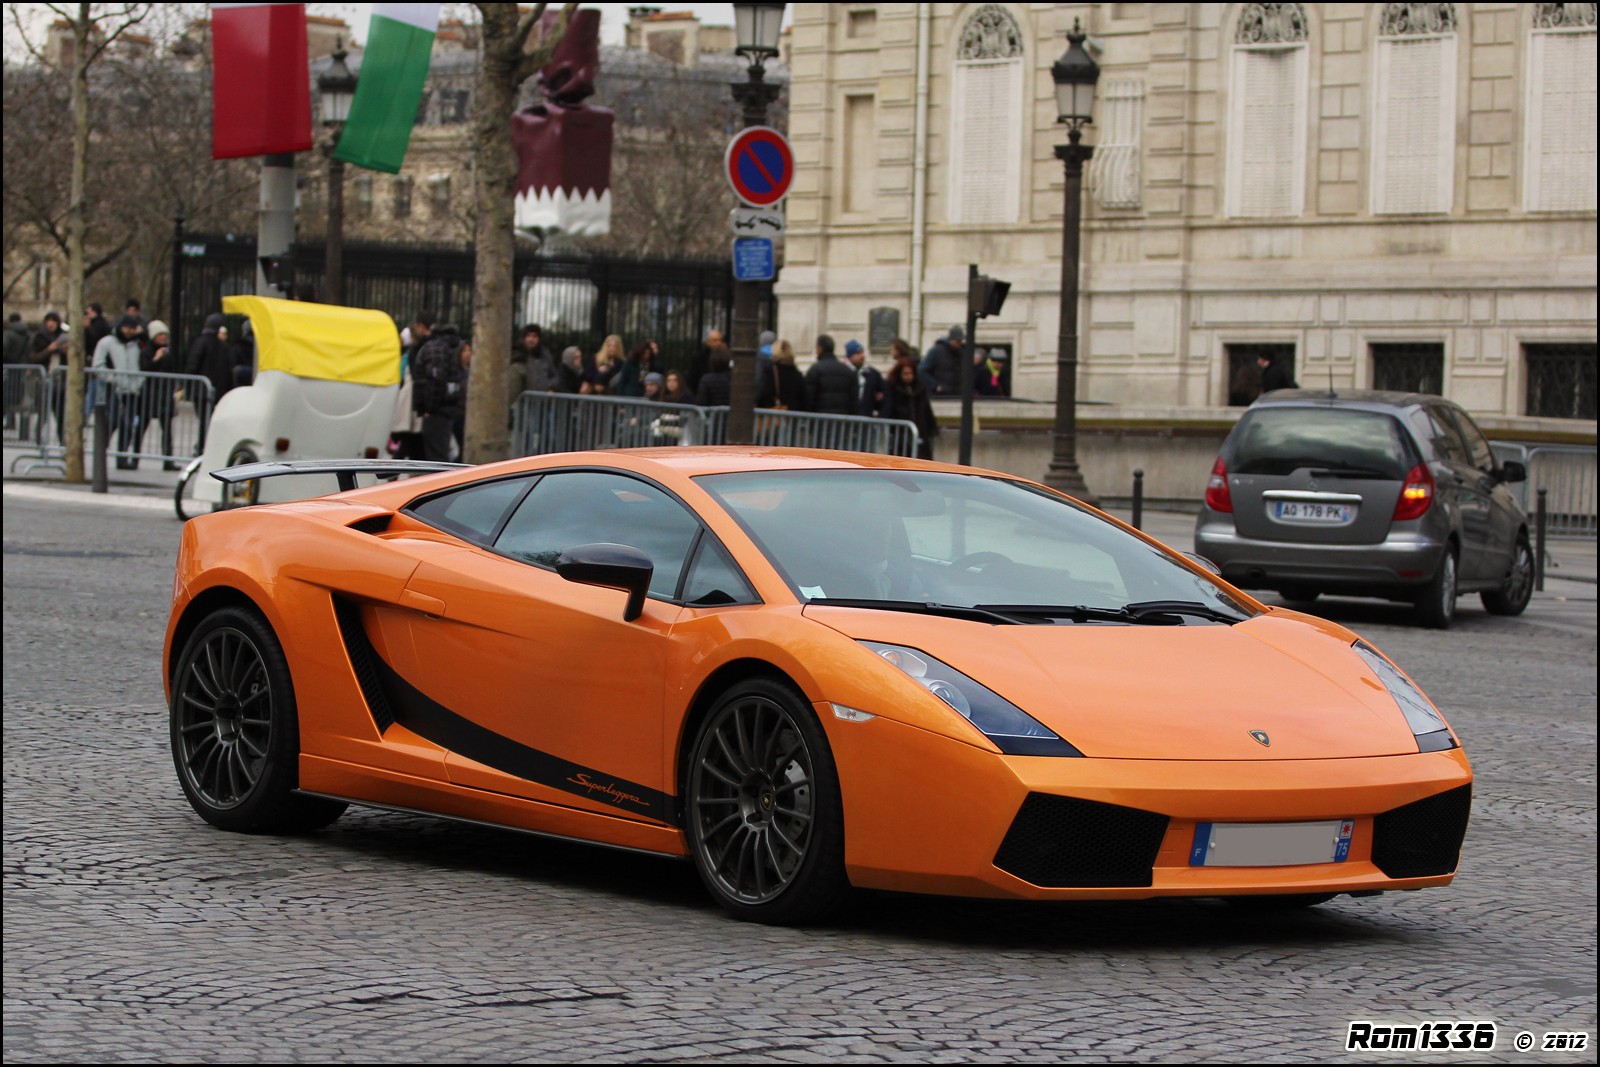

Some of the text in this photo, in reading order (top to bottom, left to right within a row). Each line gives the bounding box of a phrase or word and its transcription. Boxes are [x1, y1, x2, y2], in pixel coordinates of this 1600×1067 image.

[1303, 505, 1322, 517] 178
[1326, 506, 1341, 518] PK
[1336, 842, 1349, 856] 75
